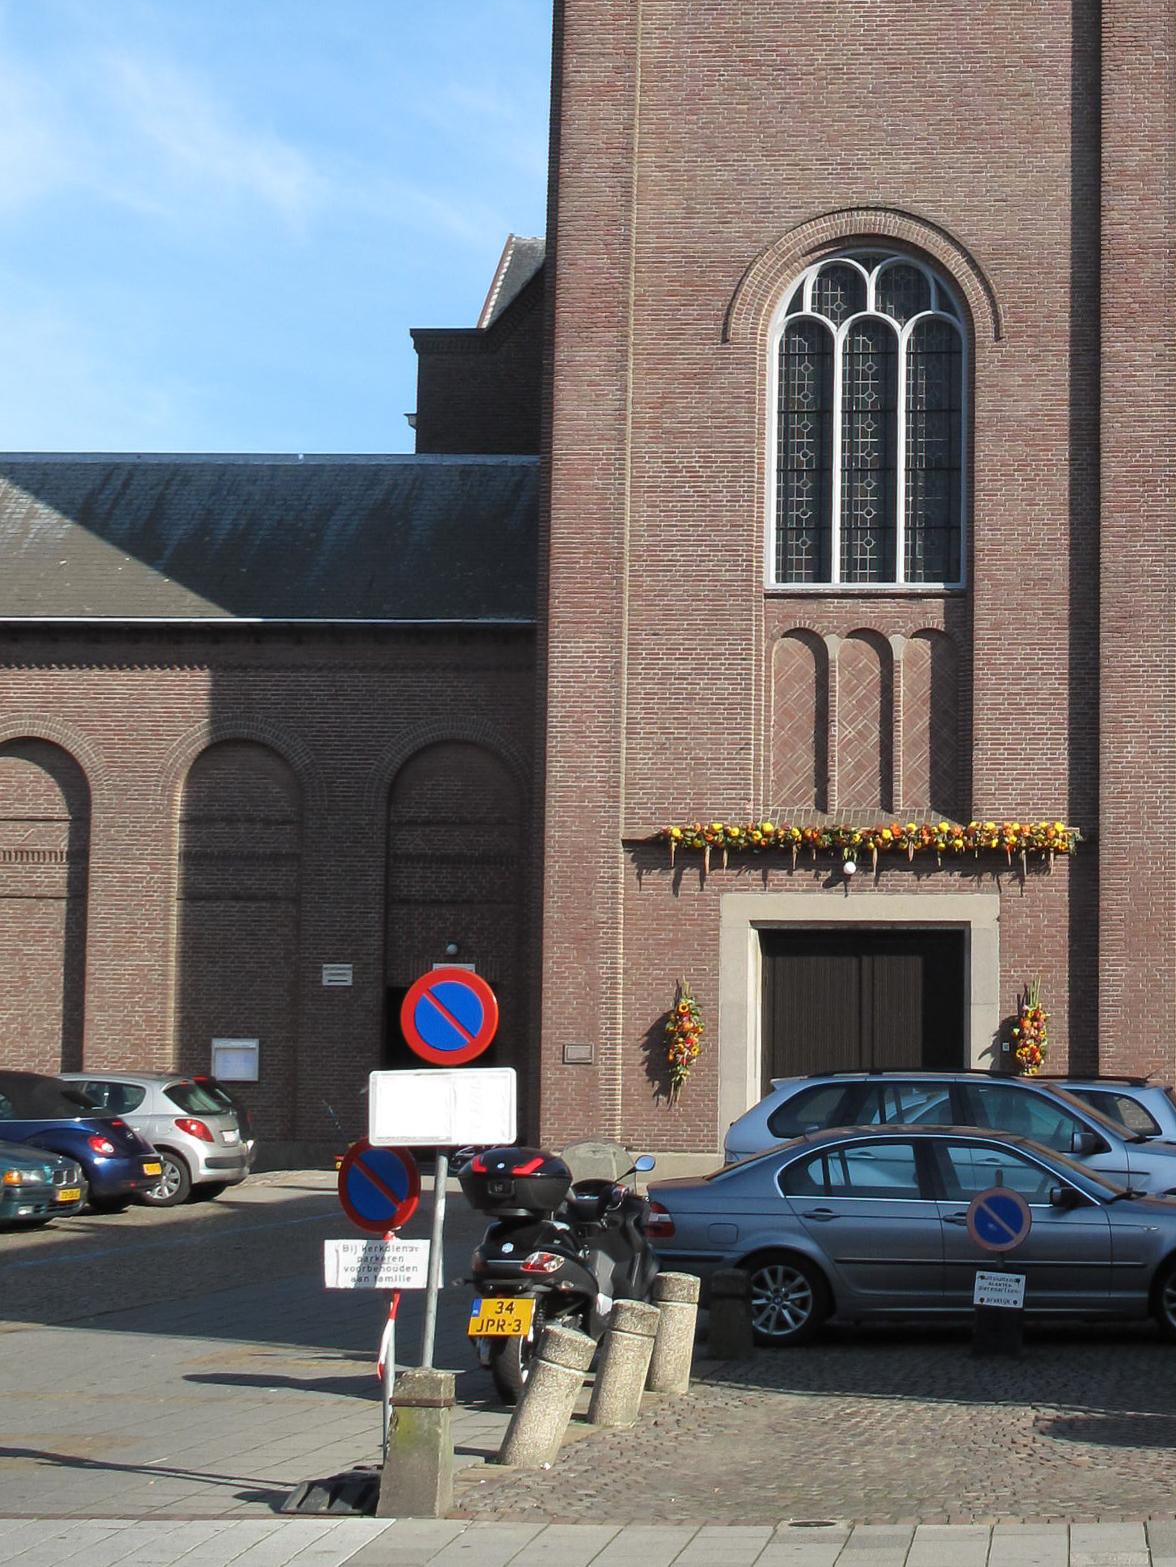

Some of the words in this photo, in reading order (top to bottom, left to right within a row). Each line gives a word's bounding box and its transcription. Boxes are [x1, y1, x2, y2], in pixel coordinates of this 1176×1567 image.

[342, 1244, 358, 1255] Bij
[357, 1255, 404, 1264] parkeren
[343, 1265, 418, 1273] voorbehouden
[374, 1275, 412, 1283] familie
[495, 1300, 516, 1315] 34
[475, 1318, 522, 1333] JPR-3
